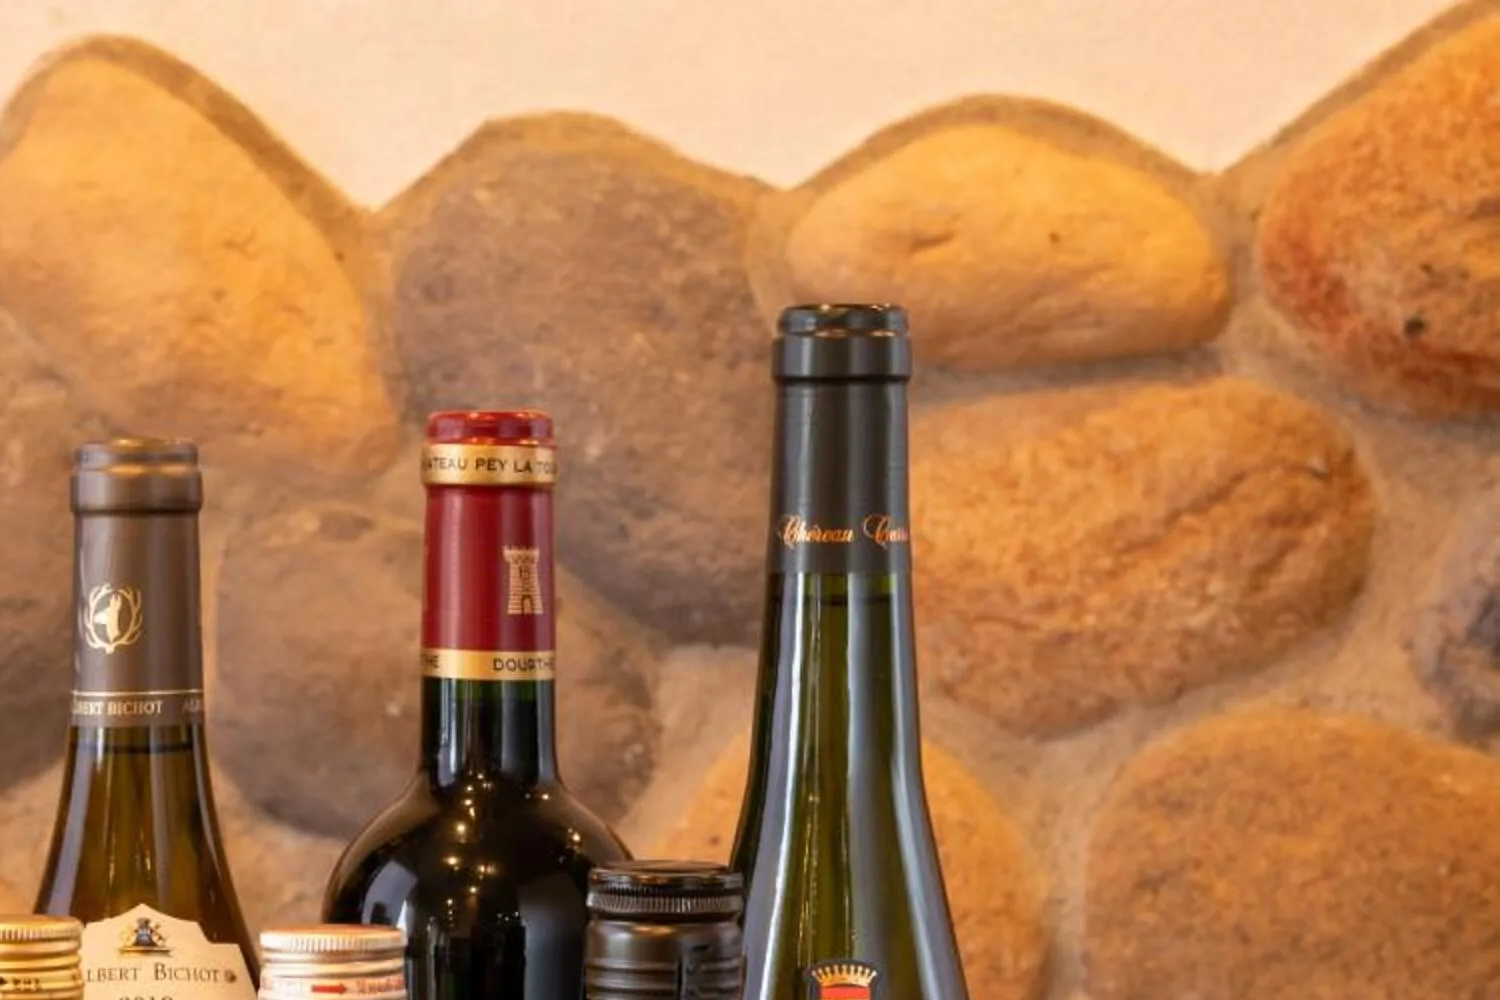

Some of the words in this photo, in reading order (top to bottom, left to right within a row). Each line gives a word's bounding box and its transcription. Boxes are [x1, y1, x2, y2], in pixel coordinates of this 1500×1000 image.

[426, 456, 468, 471] ATEAU
[475, 457, 506, 471] PEY
[514, 459, 532, 474] LA
[107, 700, 164, 715] BICHOT
[86, 966, 140, 983] LBERT
